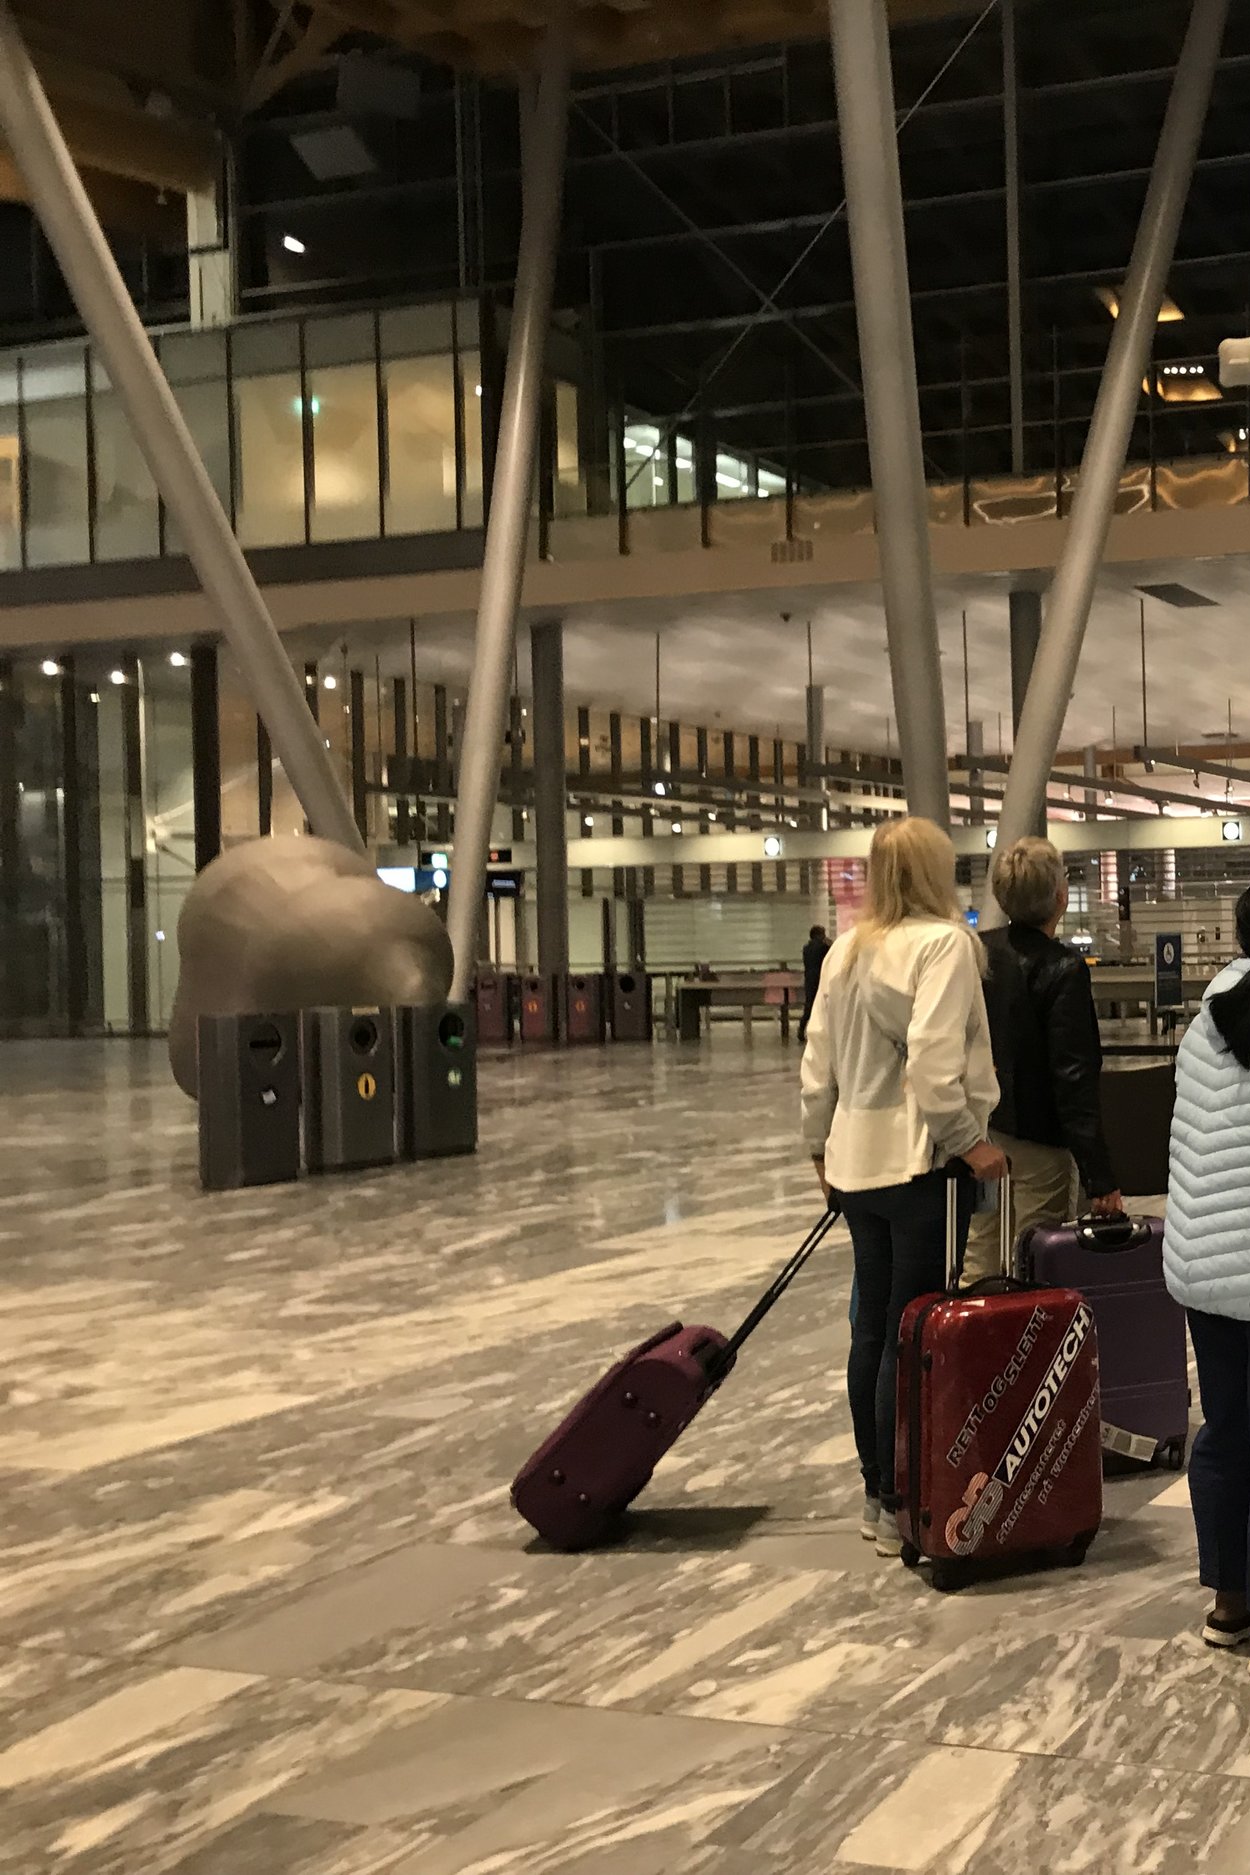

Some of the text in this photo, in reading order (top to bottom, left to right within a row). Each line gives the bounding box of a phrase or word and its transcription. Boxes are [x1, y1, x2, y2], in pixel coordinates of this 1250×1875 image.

[946, 1402, 986, 1469] RETT
[981, 1374, 1007, 1415] OG
[1003, 1307, 1091, 1483] AUTOTECH
